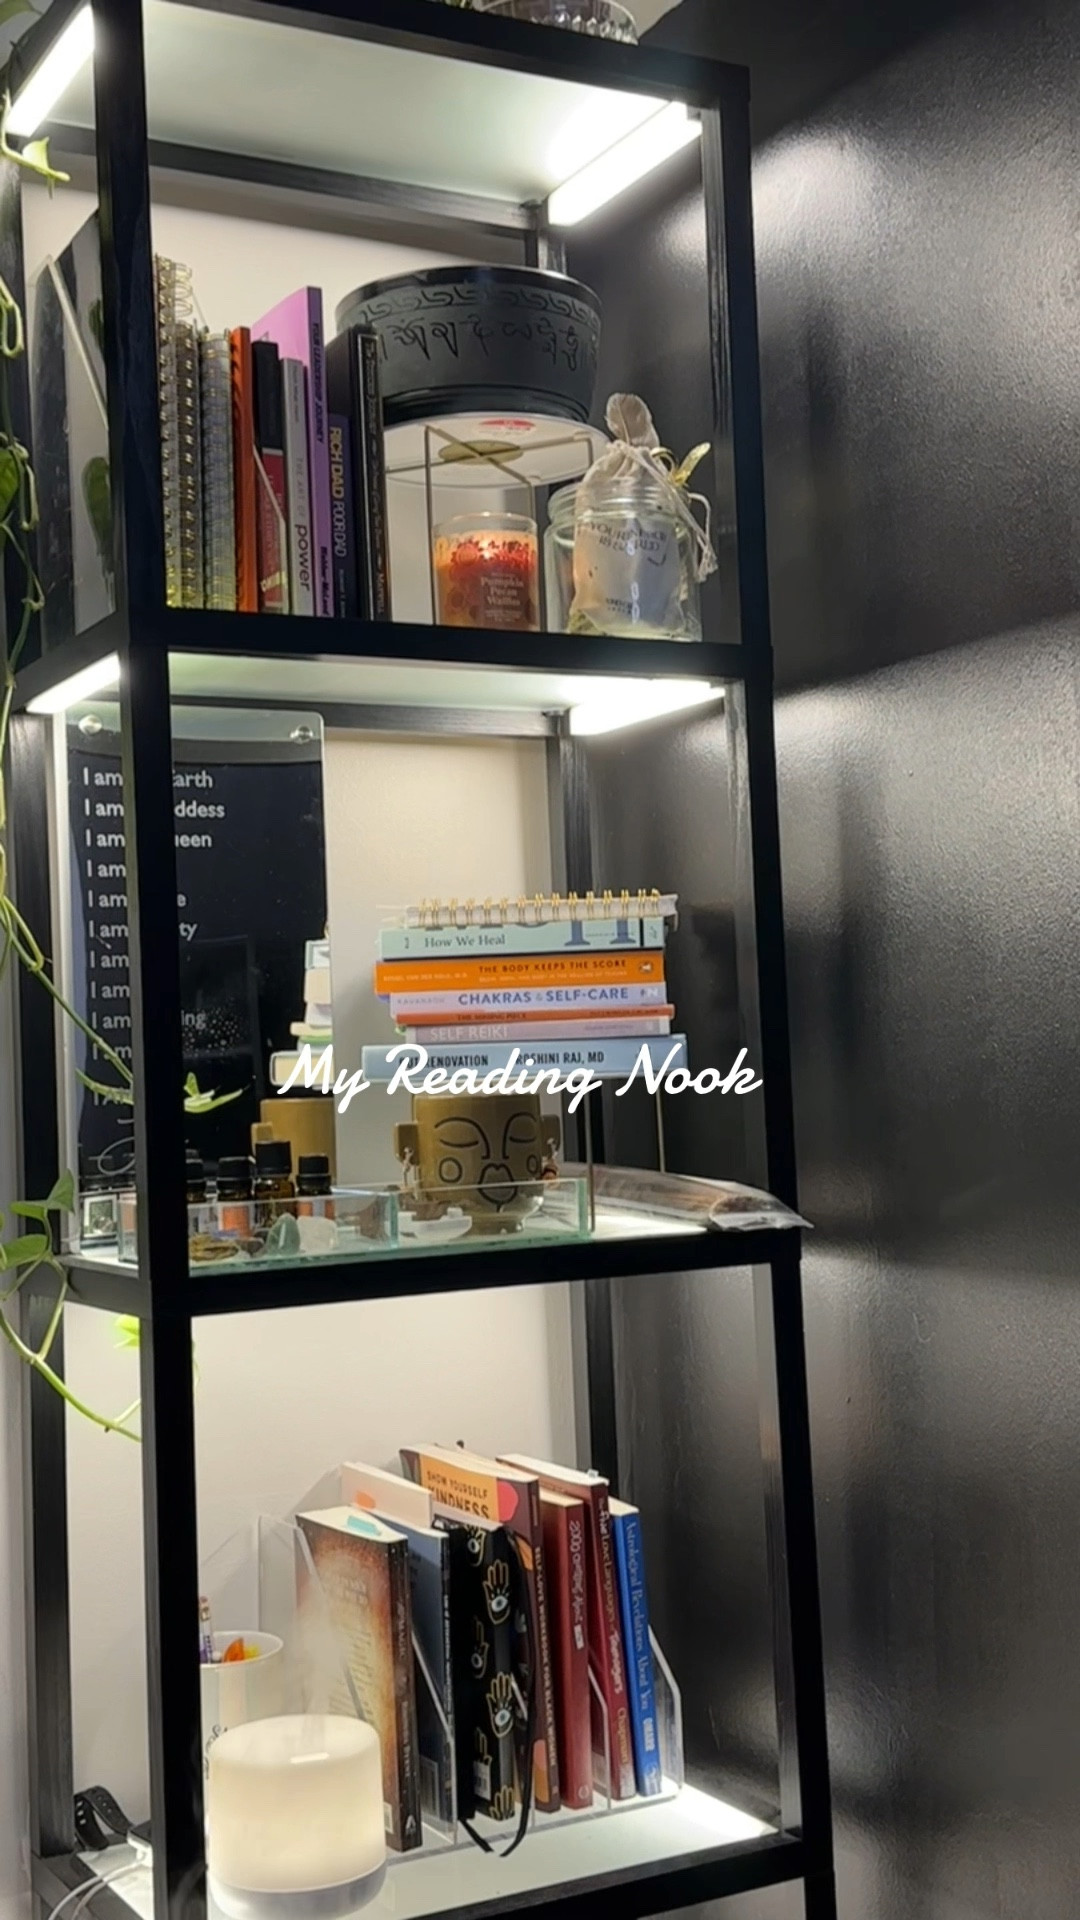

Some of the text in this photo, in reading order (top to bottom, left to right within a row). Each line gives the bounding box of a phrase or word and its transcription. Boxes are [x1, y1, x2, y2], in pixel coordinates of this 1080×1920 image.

[330, 427, 343, 461] RICH
[331, 464, 344, 498] DAD
[333, 500, 346, 530] POOR
[334, 531, 346, 557] DAD
[294, 523, 310, 592] power
[84, 768, 213, 788] I am arth
[84, 798, 226, 818] I am ddess
[86, 829, 90, 847] I
[96, 834, 125, 847] am
[87, 860, 126, 877] I am
[88, 890, 127, 908] I am
[90, 920, 128, 938] I am
[425, 934, 506, 948] How We Heal
[90, 951, 129, 968] I am
[479, 959, 626, 974] THE BODY KEEPS THE SCORE
[91, 981, 130, 998] I am
[458, 990, 532, 1005] CHAKRAS
[92, 1012, 131, 1028] I am
[430, 1026, 508, 1041] SELF REIKI
[93, 1043, 98, 1060] I
[516, 1052, 560, 1065] ROSHINI
[588, 1051, 604, 1063] MD
[427, 1470, 488, 1500] SHOW YOURSELF
[626, 1521, 651, 1710] Astrological Revelations About You
[540, 1604, 548, 1663] WORKBOOK
[545, 1688, 554, 1724] BLACK
[548, 1726, 557, 1766] WOMEN
